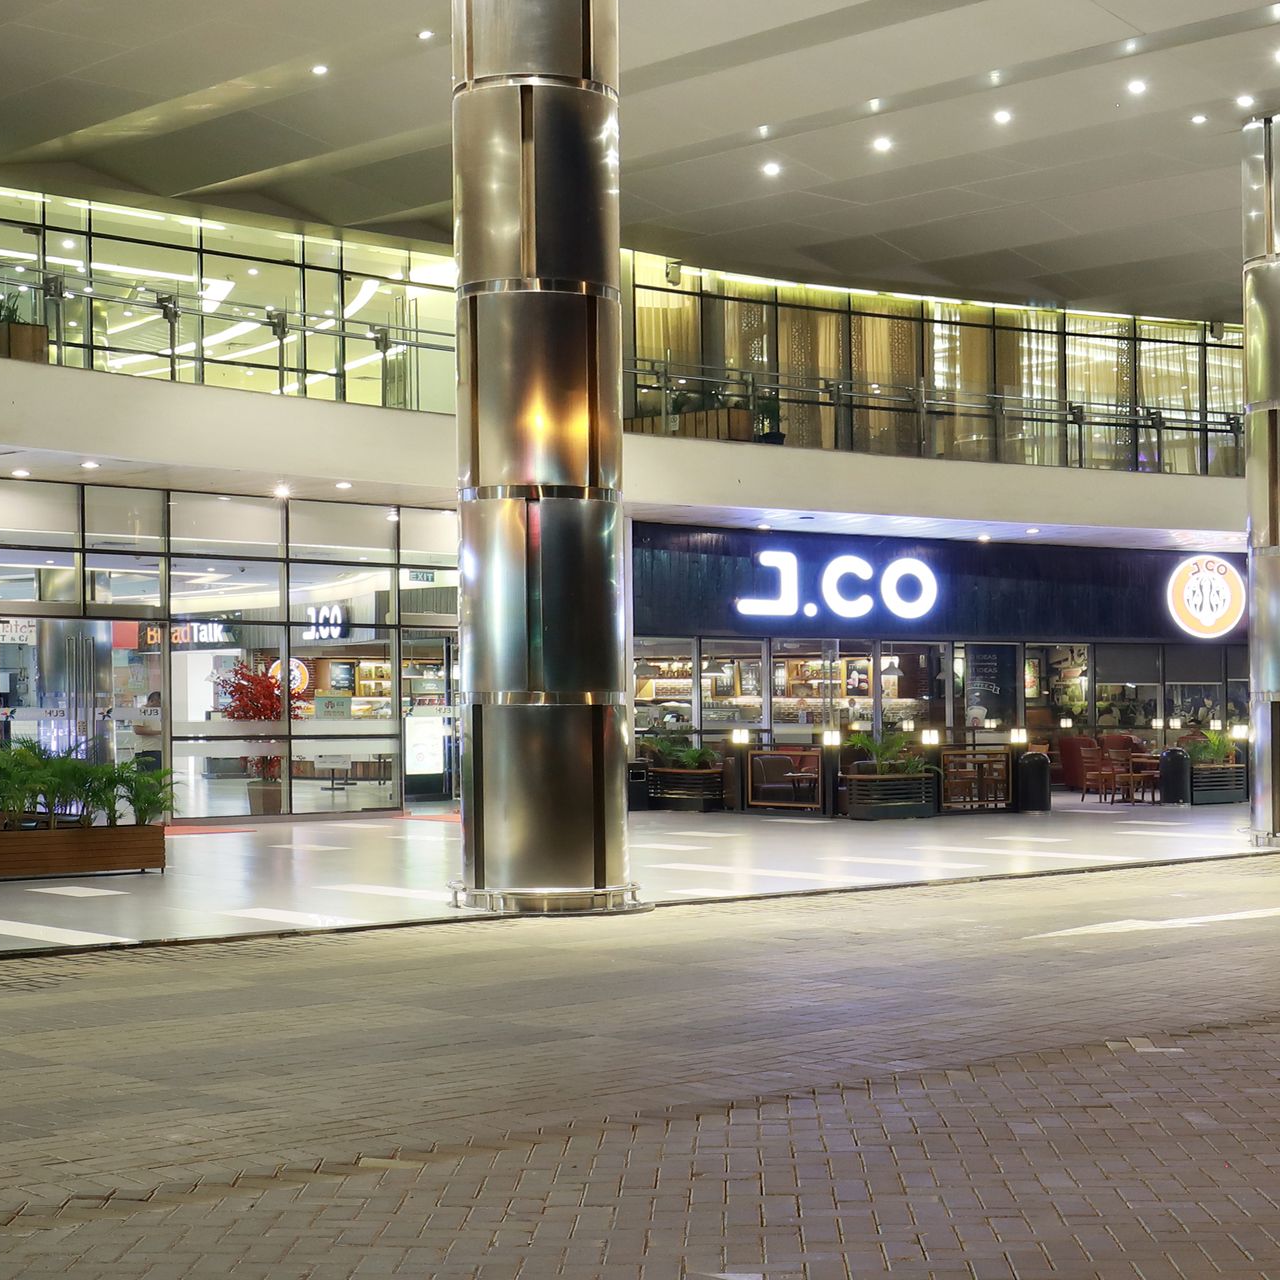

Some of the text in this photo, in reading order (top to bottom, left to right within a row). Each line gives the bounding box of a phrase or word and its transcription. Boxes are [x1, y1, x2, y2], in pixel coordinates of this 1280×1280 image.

[410, 573, 434, 581] EXIT
[735, 549, 939, 620] J.CO
[146, 623, 224, 645] BadTalk
